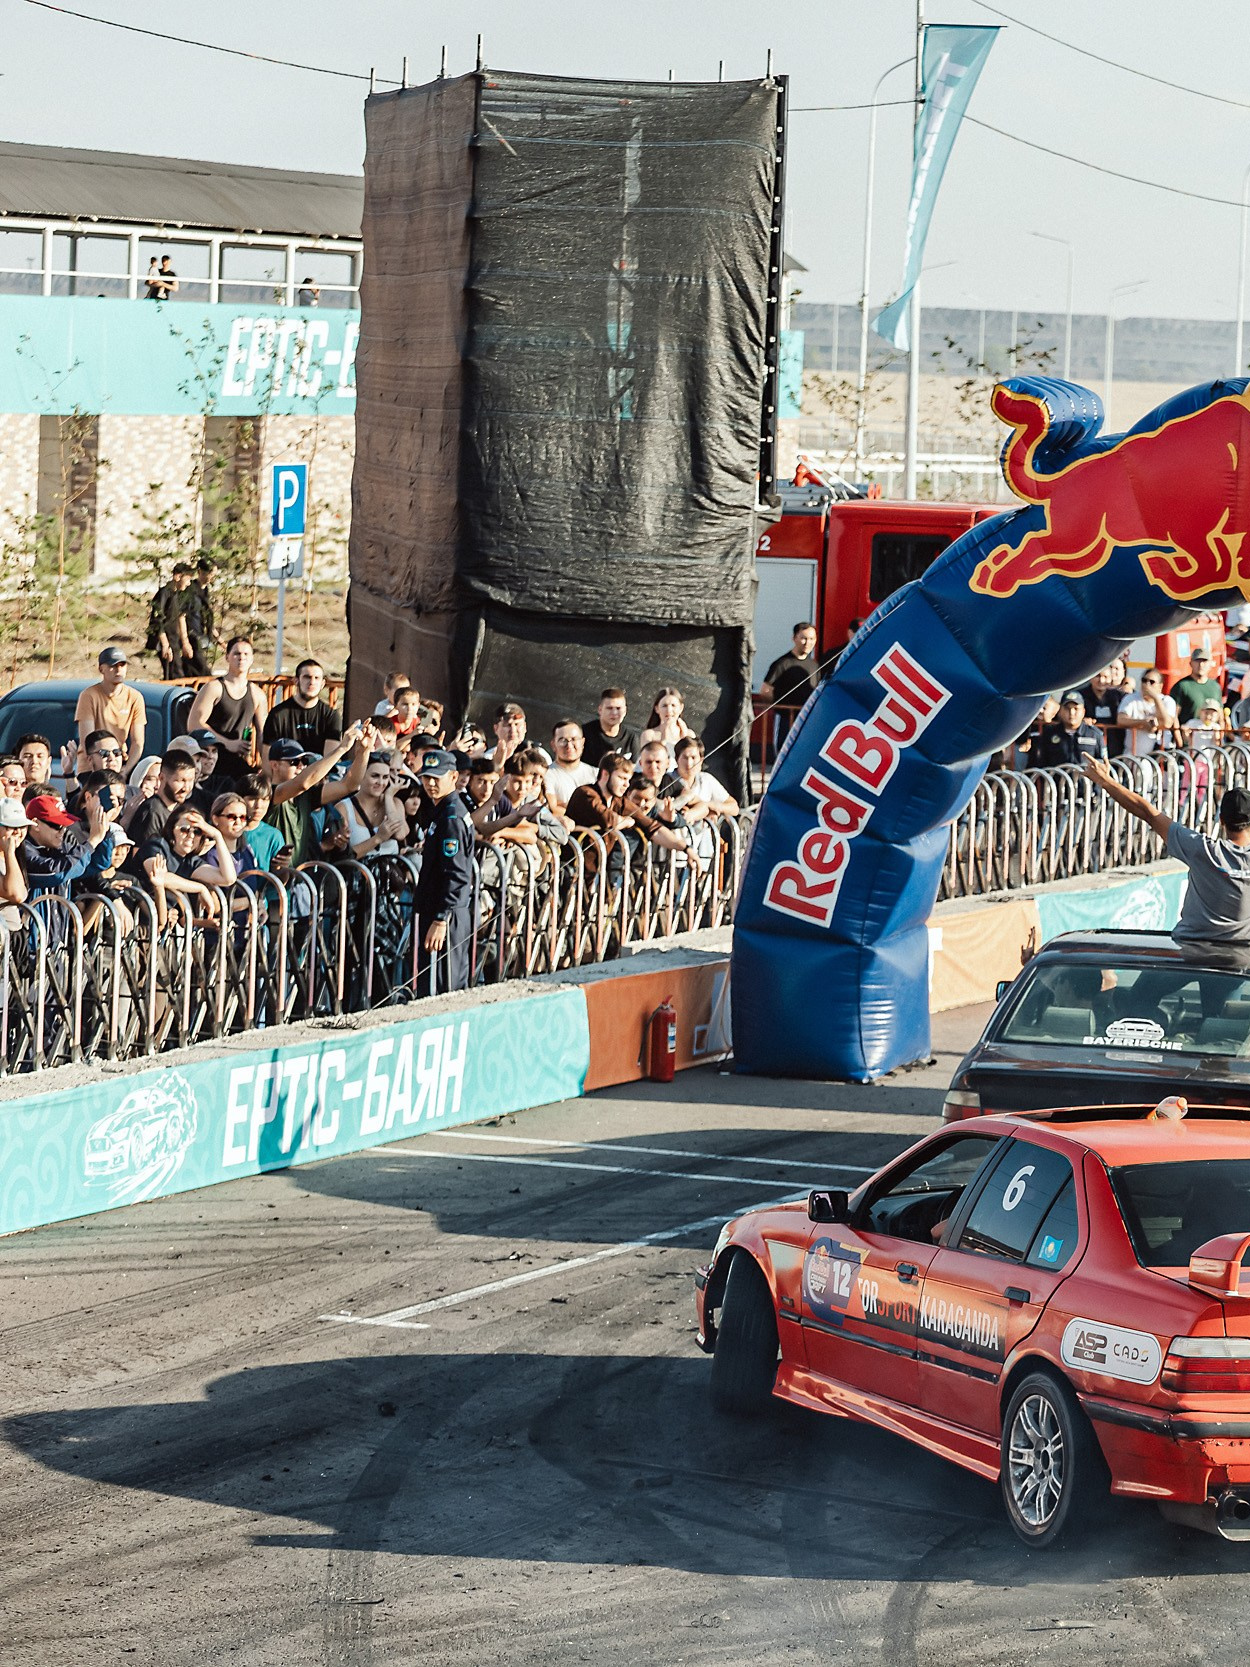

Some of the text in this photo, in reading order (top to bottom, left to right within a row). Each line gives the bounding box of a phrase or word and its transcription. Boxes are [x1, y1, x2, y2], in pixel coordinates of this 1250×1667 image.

[277, 469, 300, 531] P
[765, 643, 951, 926] Red Bull
[1082, 1036, 1183, 1051] BAYERISCHE
[222, 1021, 470, 1168] ЕРТІС-БАЯН
[1002, 1165, 1036, 1211] 6
[833, 1260, 852, 1298] 12
[920, 1294, 999, 1351] KARAGANDA
[1075, 1330, 1108, 1351] ASP
